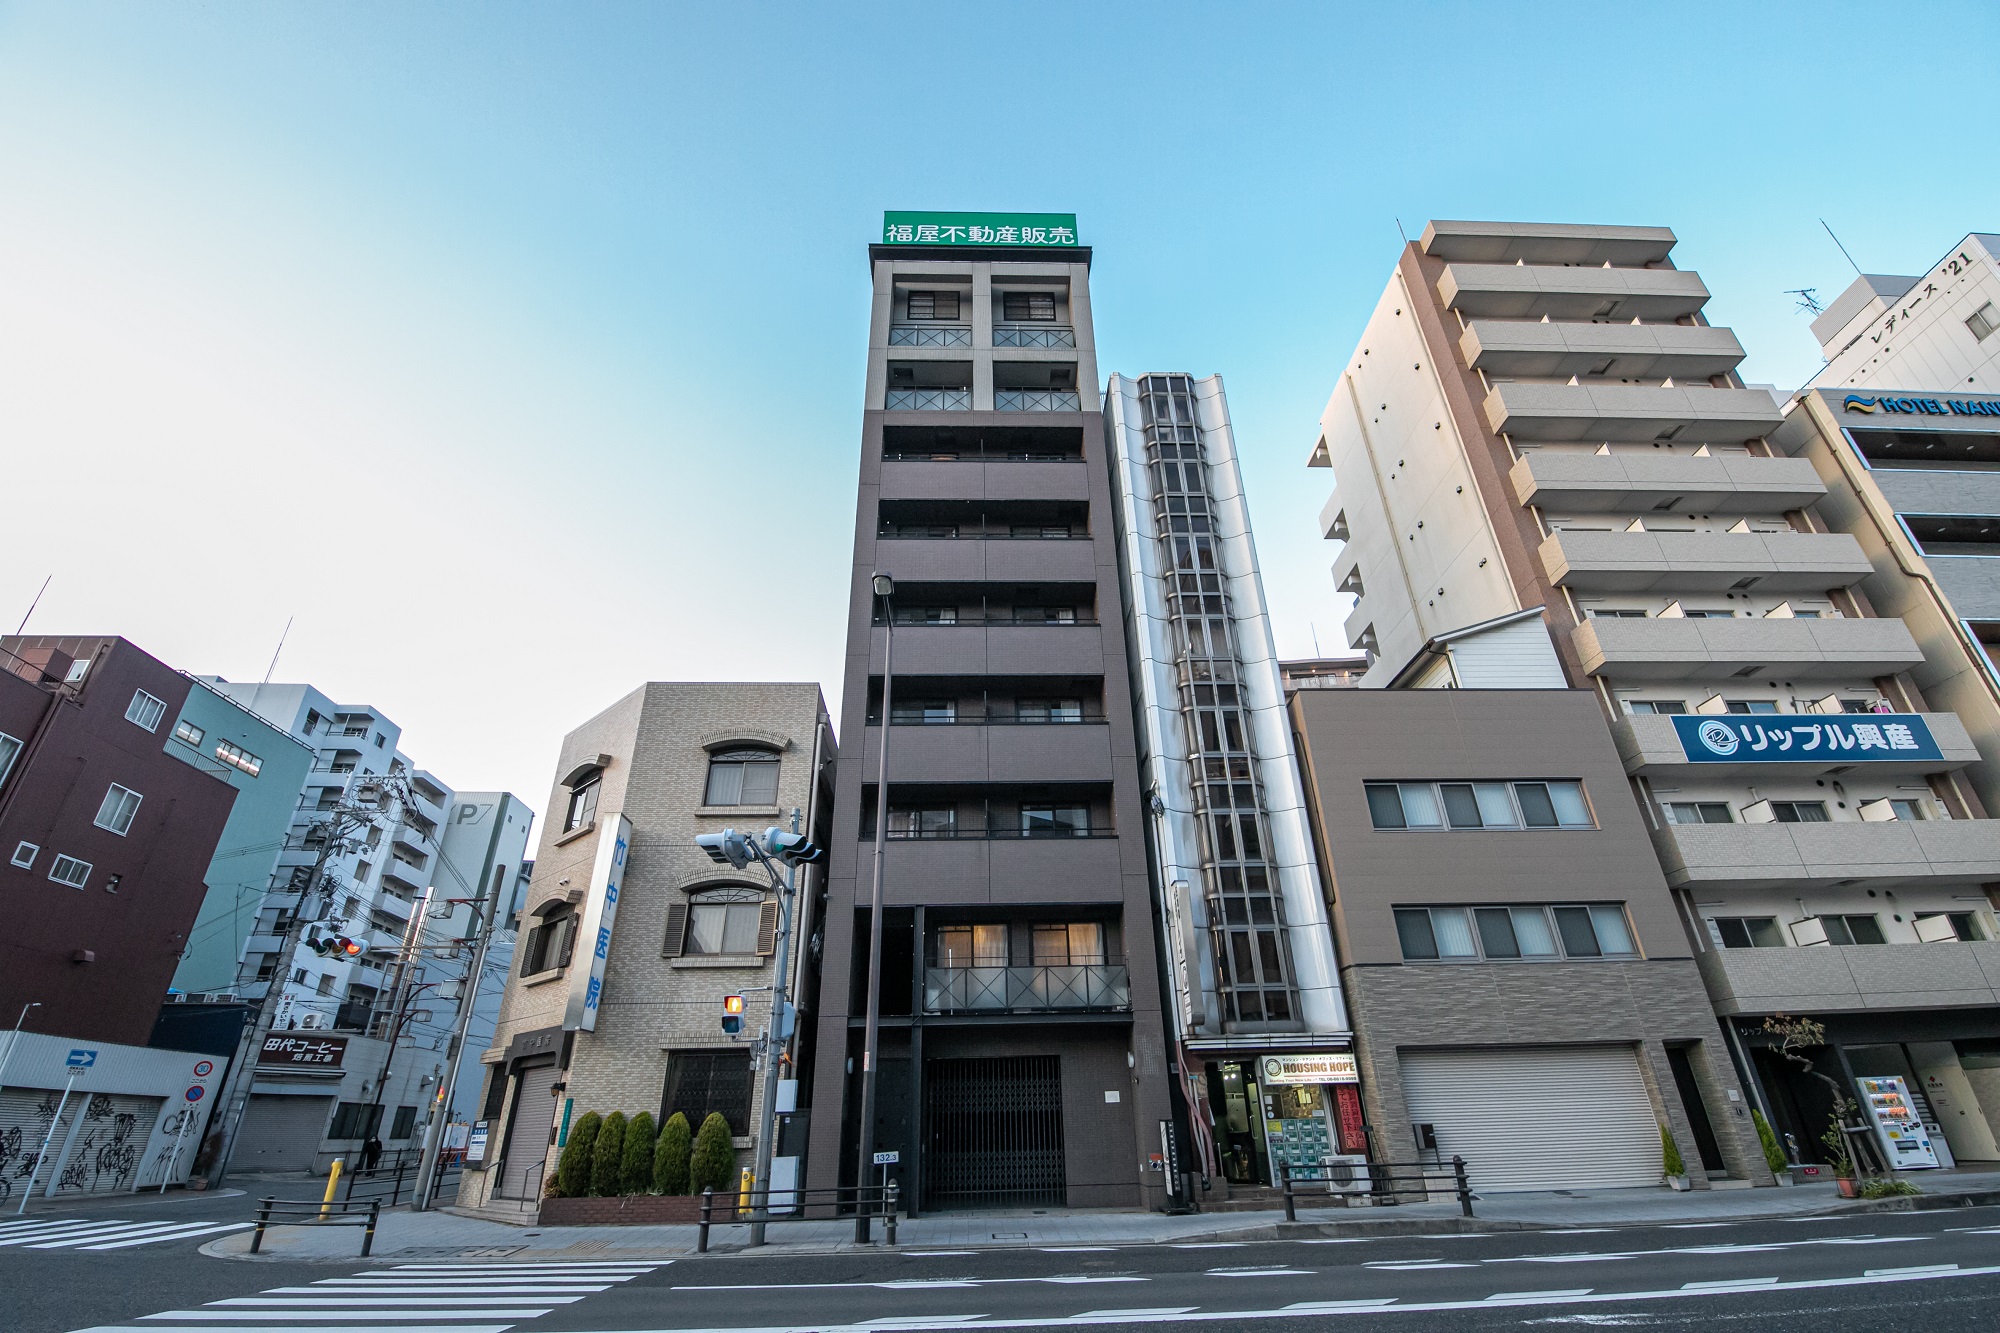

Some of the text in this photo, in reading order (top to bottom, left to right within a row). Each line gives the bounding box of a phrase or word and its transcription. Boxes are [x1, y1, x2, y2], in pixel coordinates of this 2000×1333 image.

[885, 224, 1075, 244] 福屋不動産販売
[1870, 283, 1938, 344] レディース
[1878, 396, 2000, 416] HOTEL NAN
[1739, 723, 1919, 751] リップル興産
[584, 833, 627, 1010] 竹中医院
[263, 1038, 343, 1054] 田代コーヒー
[197, 1065, 210, 1073] 30
[1282, 1061, 1356, 1074] HOUSING HOPE
